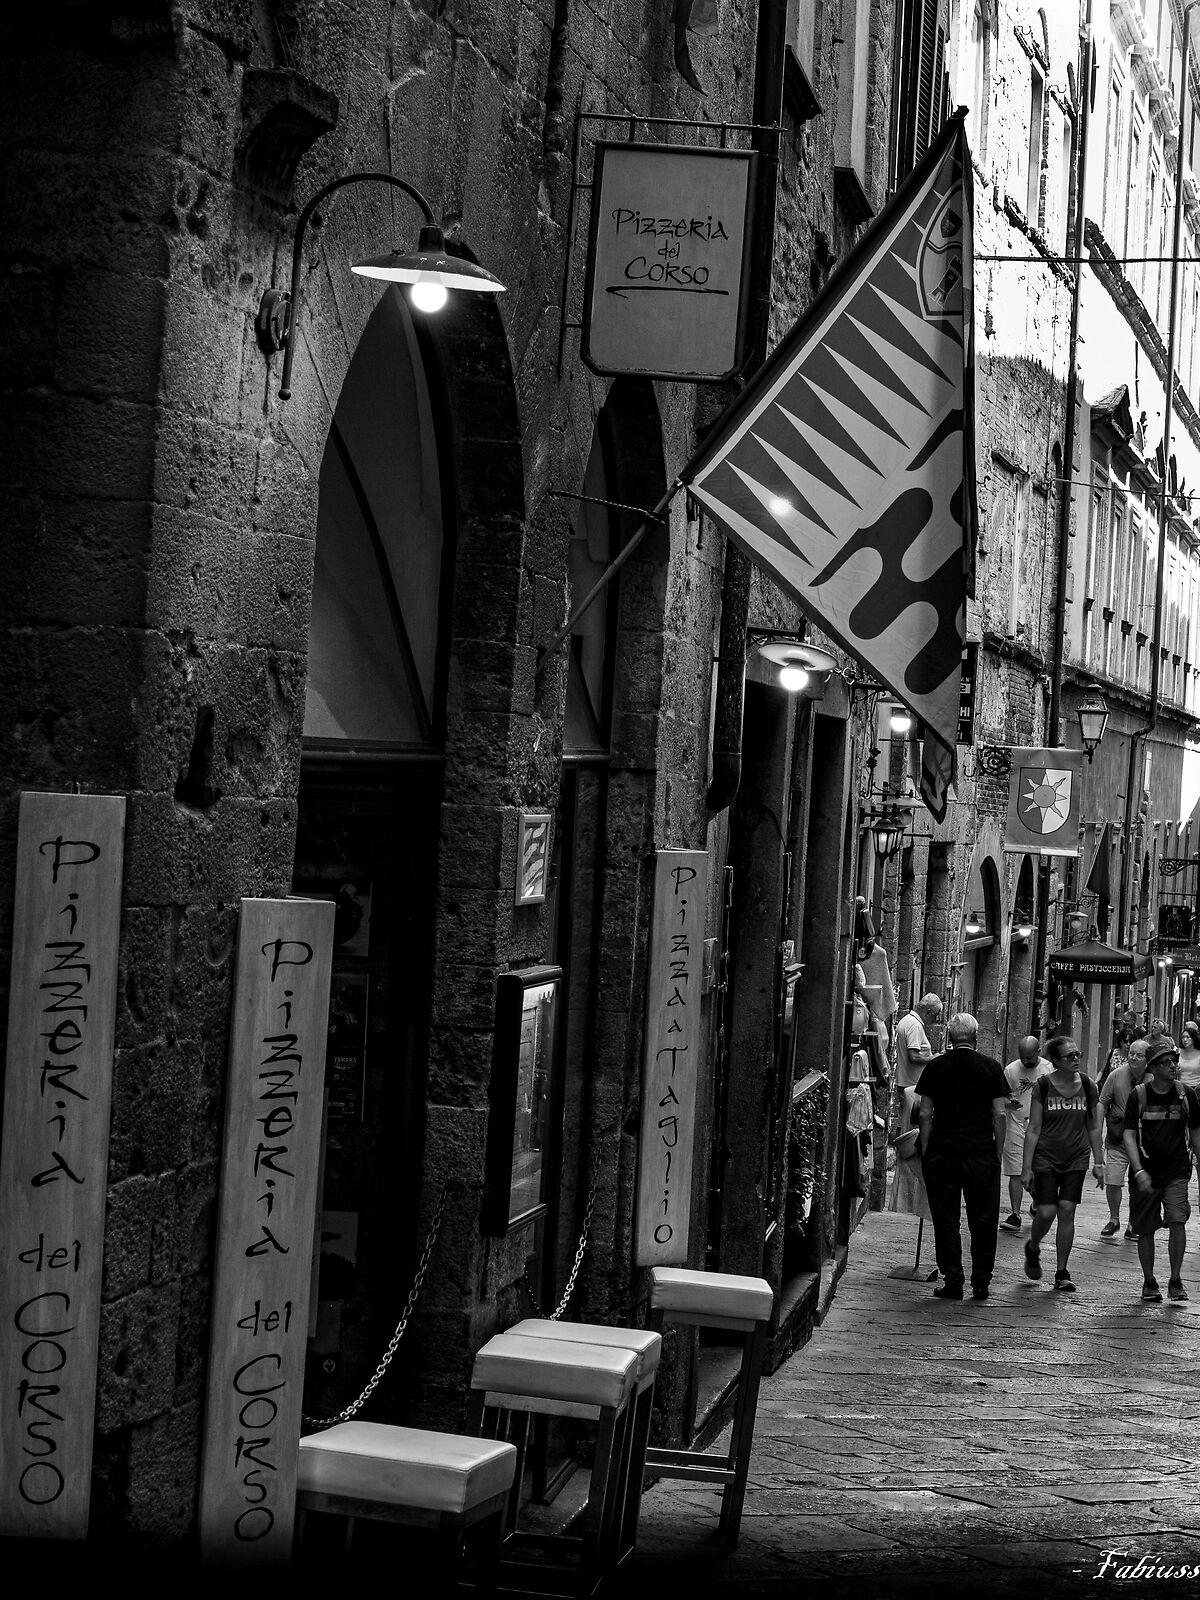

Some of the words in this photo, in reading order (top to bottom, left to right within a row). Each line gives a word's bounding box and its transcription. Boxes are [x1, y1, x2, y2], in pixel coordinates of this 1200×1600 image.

[657, 240, 681, 260] del
[666, 866, 697, 1008] Pizza
[17, 1232, 82, 1274] del
[236, 1300, 292, 1337] del
